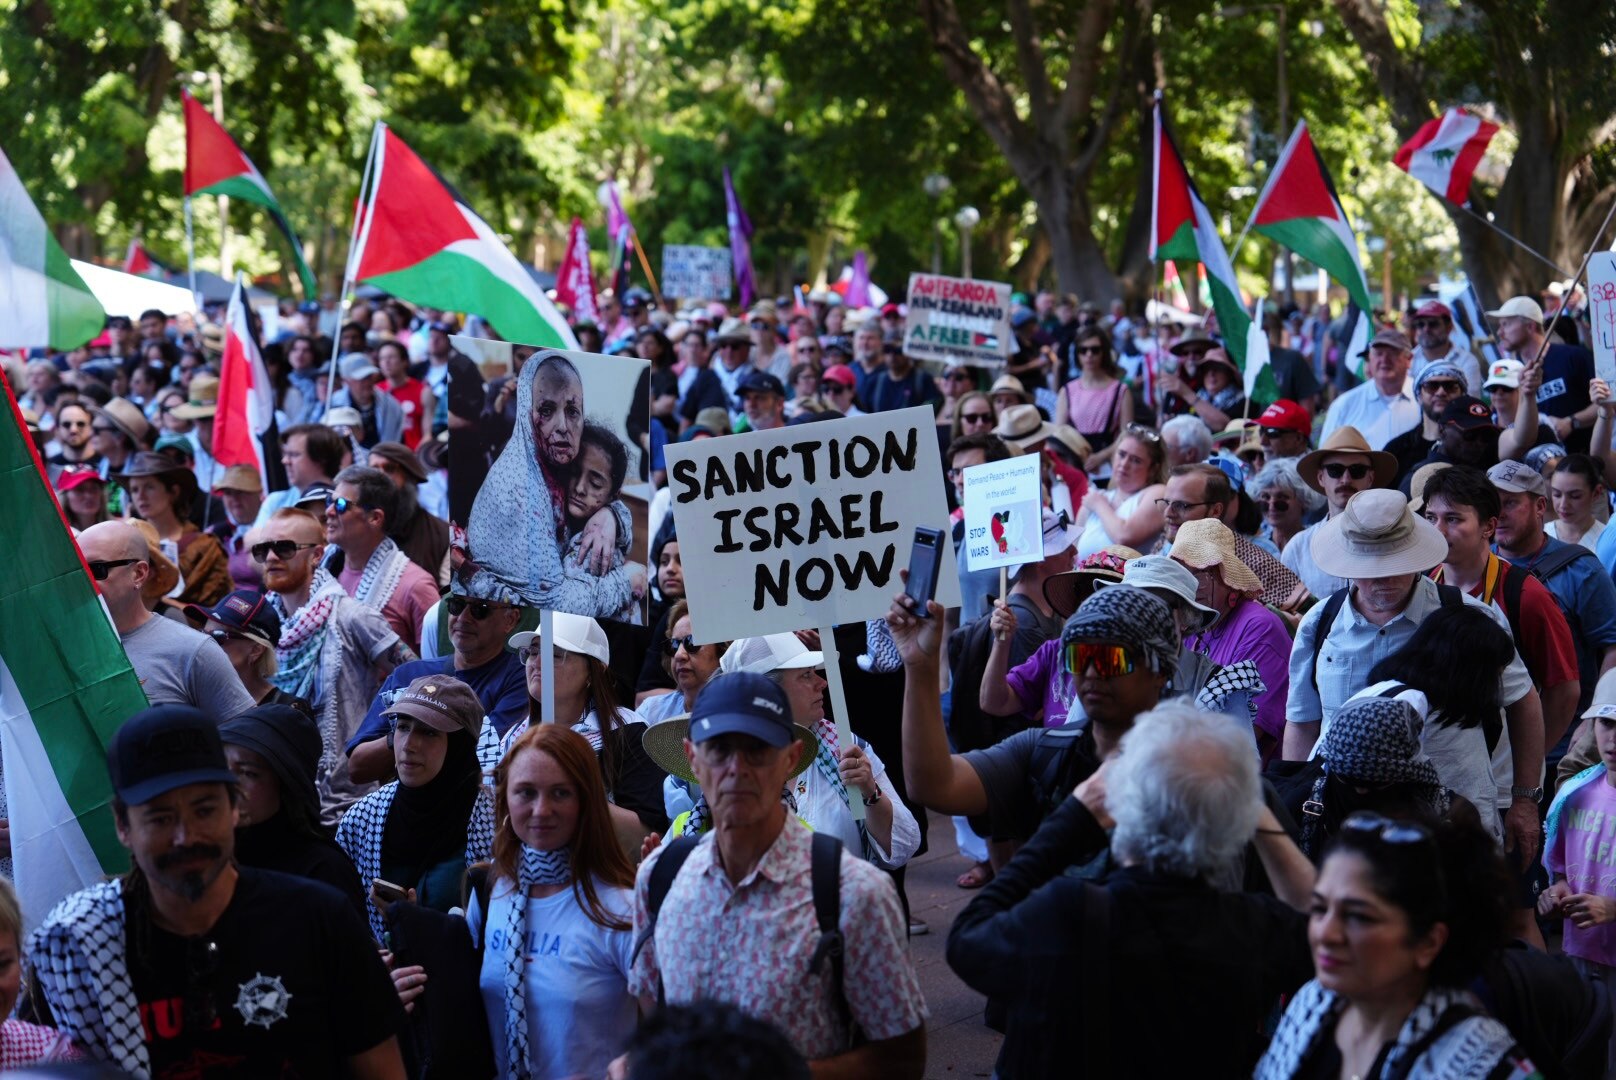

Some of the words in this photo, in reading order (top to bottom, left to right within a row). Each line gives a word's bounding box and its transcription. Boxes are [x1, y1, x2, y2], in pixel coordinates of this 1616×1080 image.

[913, 276, 997, 305] AOTEAROA
[940, 298, 1003, 321] ZEALAND
[911, 324, 925, 340] A
[929, 326, 970, 345] FREE
[672, 427, 917, 503] SANCTION
[989, 472, 1005, 481] Peace
[1010, 466, 1035, 477] Humanity
[713, 490, 899, 553] ISRAEL
[969, 527, 986, 539] STOP
[970, 546, 989, 558] WARS
[753, 543, 896, 611] NOW
[417, 694, 447, 709] ZEALAND
[1567, 808, 1604, 833] NICE
[491, 929, 561, 956] SIILIA
